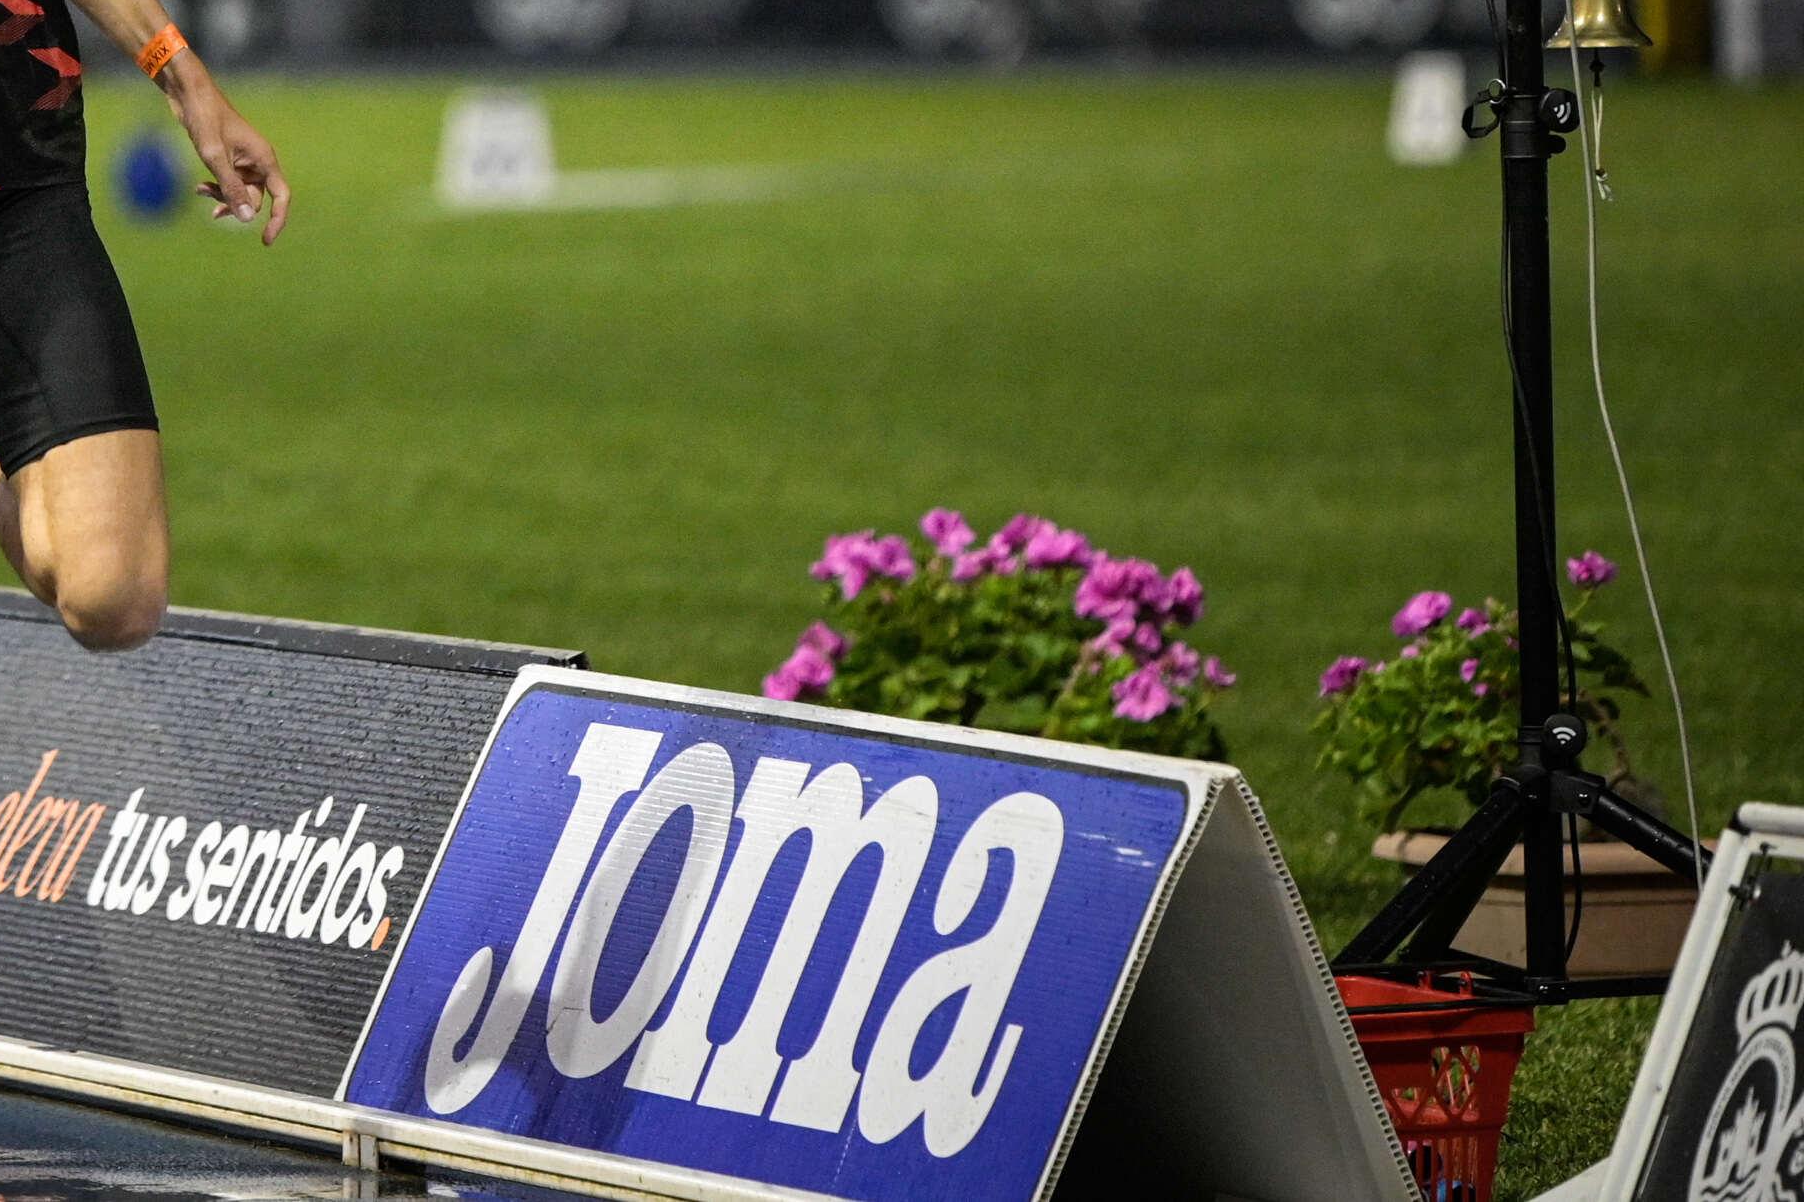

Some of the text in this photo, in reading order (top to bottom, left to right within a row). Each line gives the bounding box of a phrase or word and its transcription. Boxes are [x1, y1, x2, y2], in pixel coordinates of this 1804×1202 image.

[86, 786, 189, 916] tus
[165, 795, 405, 951] sentidos.
[424, 721, 1065, 1159] Joma
